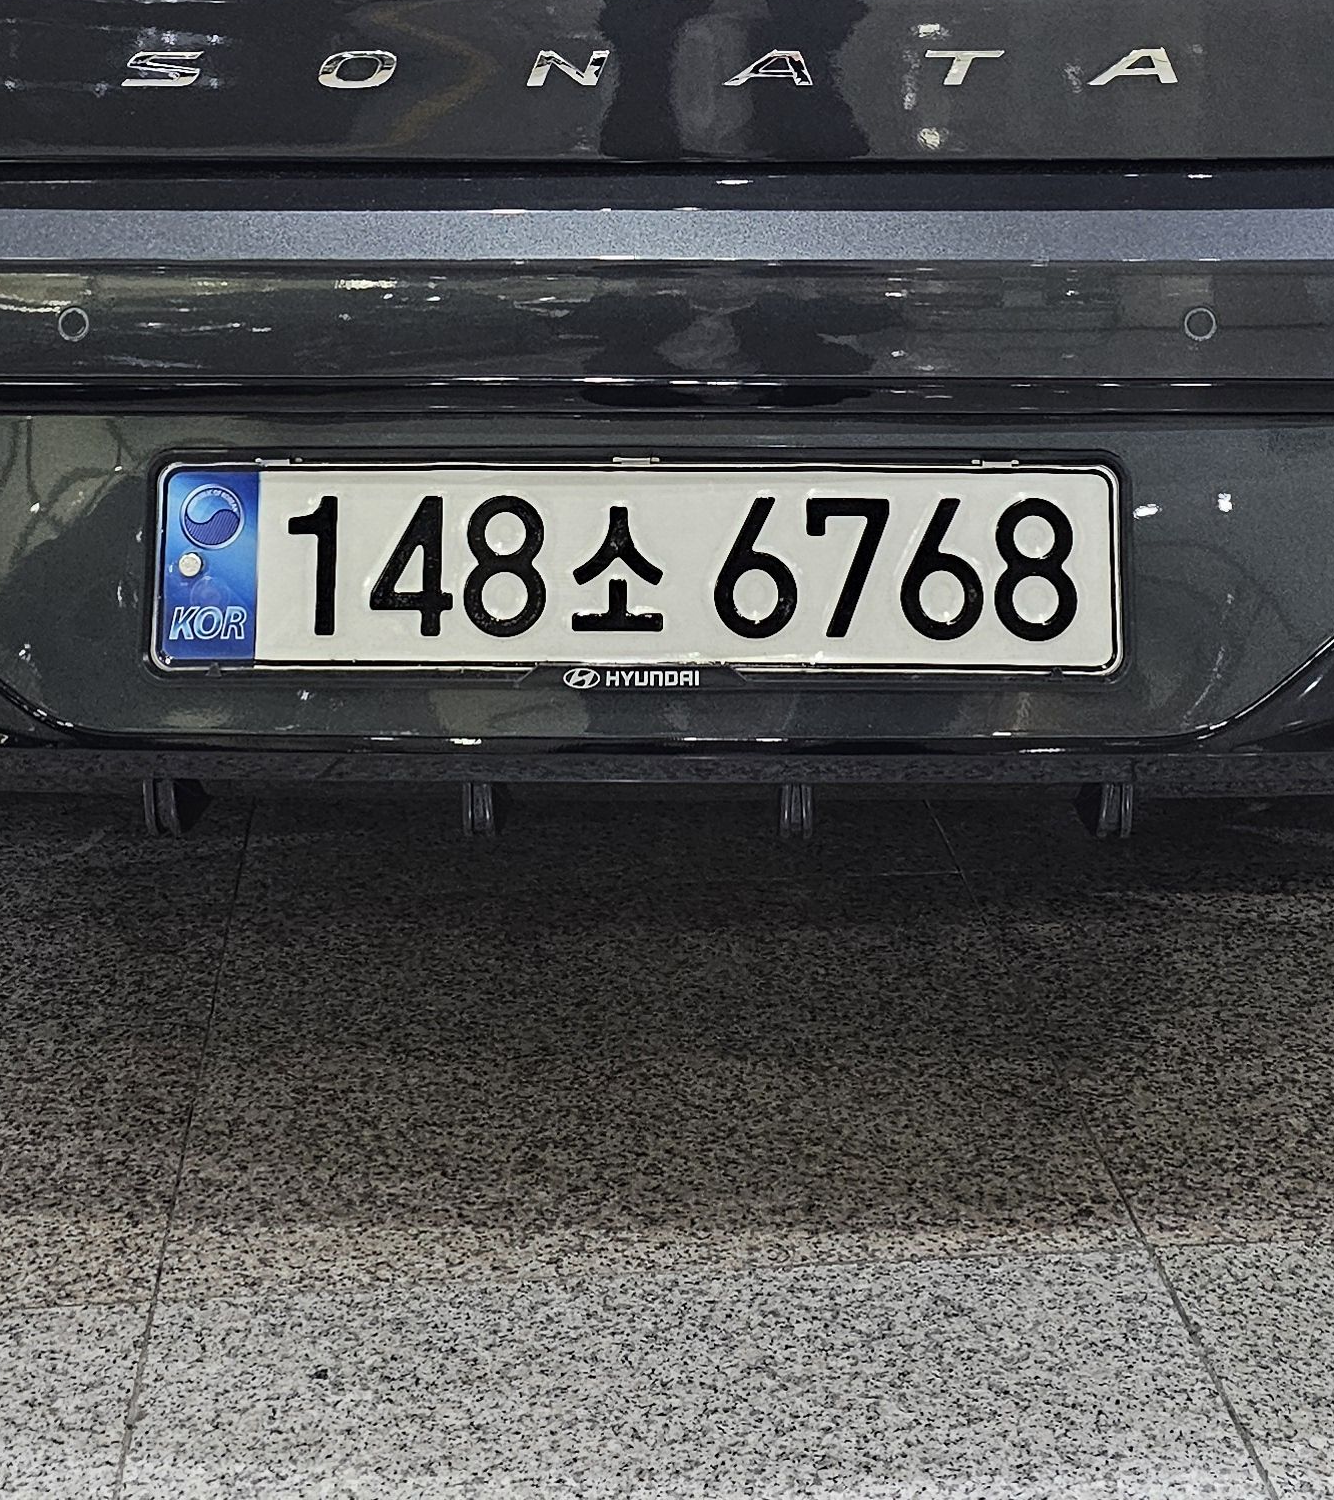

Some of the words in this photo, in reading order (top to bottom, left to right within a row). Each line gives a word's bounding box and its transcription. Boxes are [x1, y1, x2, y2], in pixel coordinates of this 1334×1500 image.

[120, 46, 1179, 90] SONATA
[287, 494, 664, 640] 148소
[713, 495, 1078, 642] 6768
[169, 605, 247, 640] KOR
[605, 669, 700, 687] HYUNDAI
